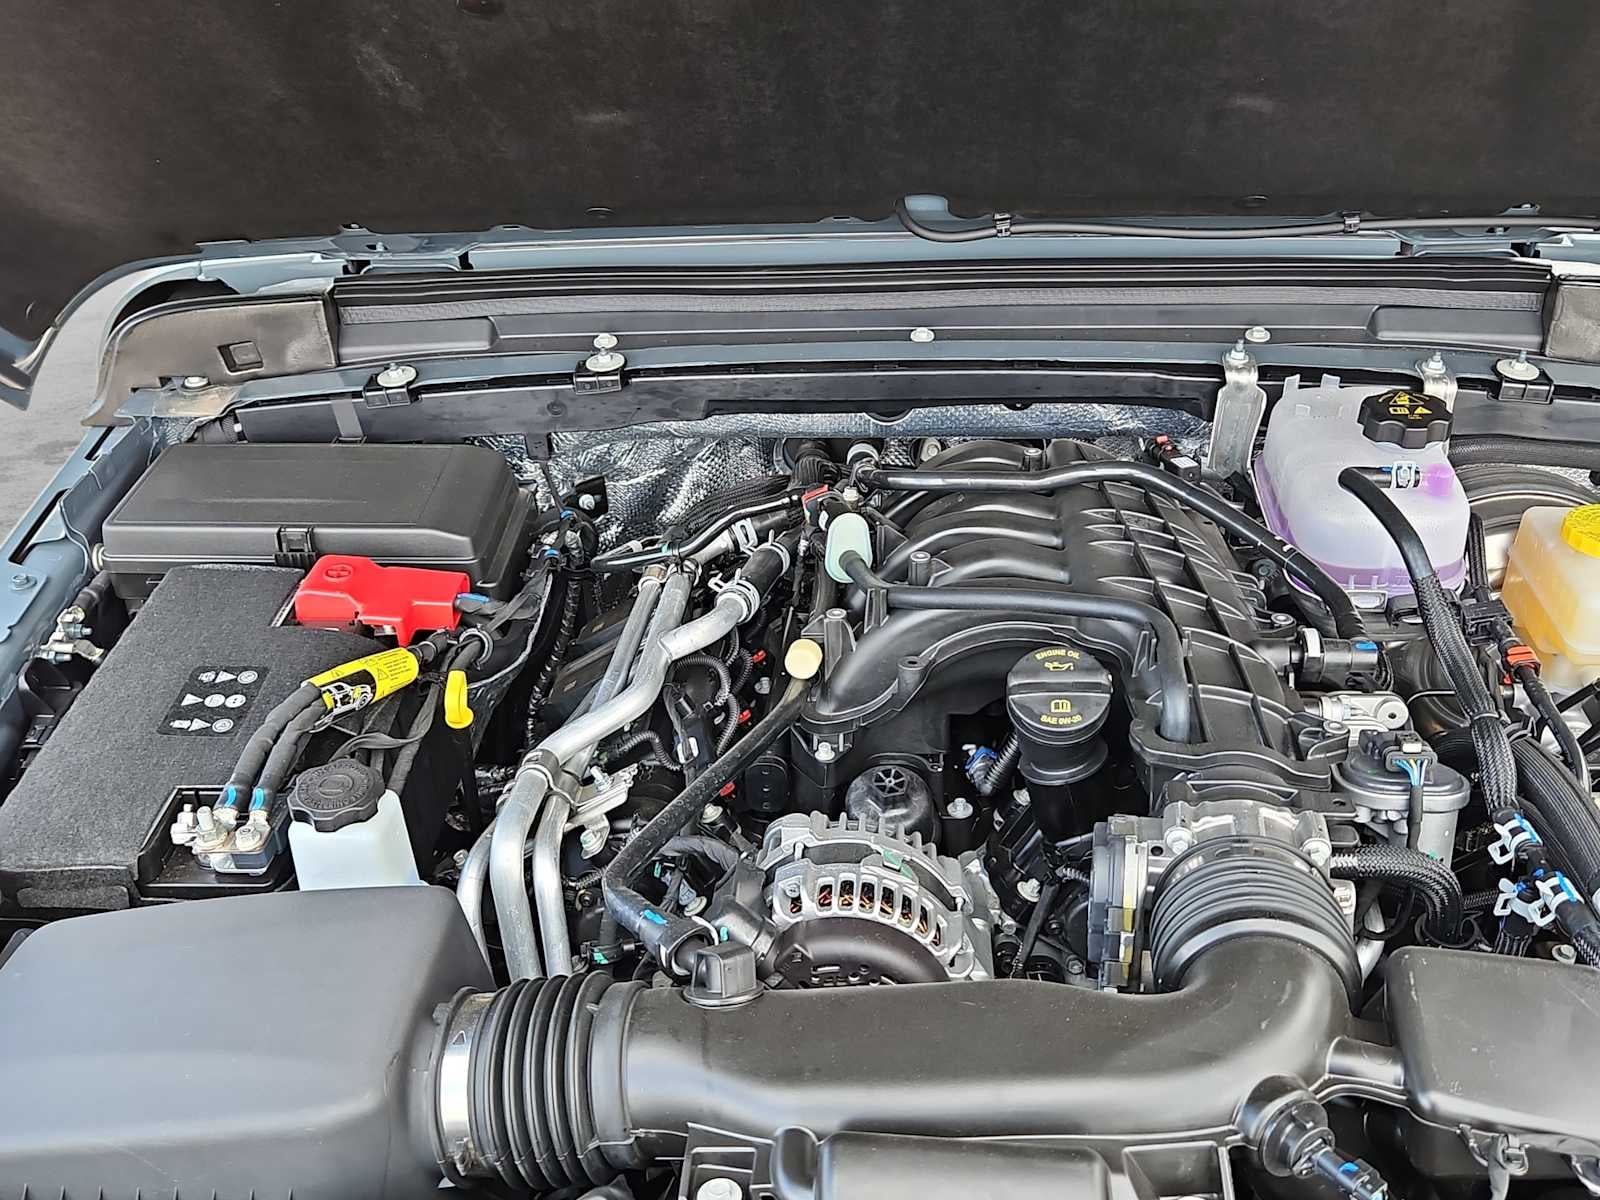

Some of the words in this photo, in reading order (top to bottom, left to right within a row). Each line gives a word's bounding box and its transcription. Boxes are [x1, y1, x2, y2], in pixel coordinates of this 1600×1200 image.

[1035, 649, 1066, 660] ENGINE
[1067, 650, 1080, 659] OIL
[1040, 714, 1057, 724] SAE
